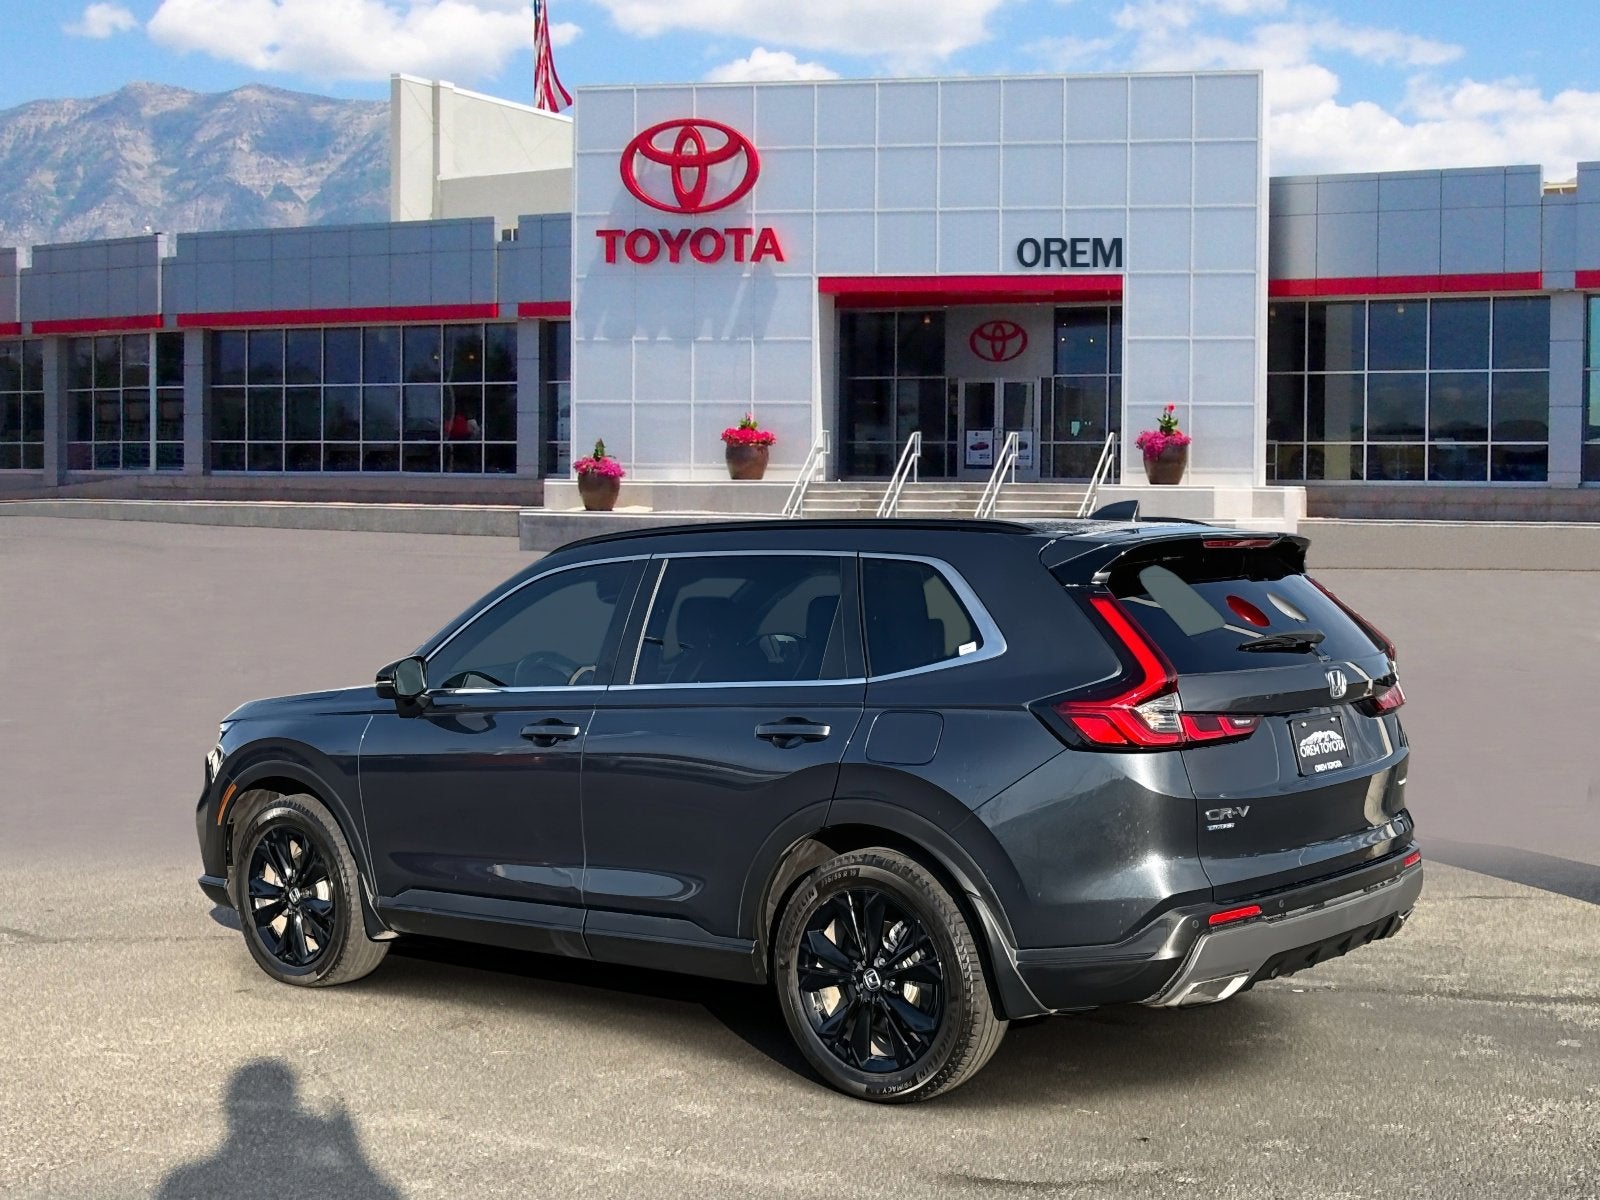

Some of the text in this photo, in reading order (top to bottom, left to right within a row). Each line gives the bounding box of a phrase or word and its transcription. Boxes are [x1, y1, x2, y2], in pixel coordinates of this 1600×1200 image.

[596, 227, 784, 264] TOYOTA
[1017, 238, 1122, 267] OREM
[1300, 740, 1345, 757] OREM TOYOTA
[1205, 806, 1250, 820] CR-V
